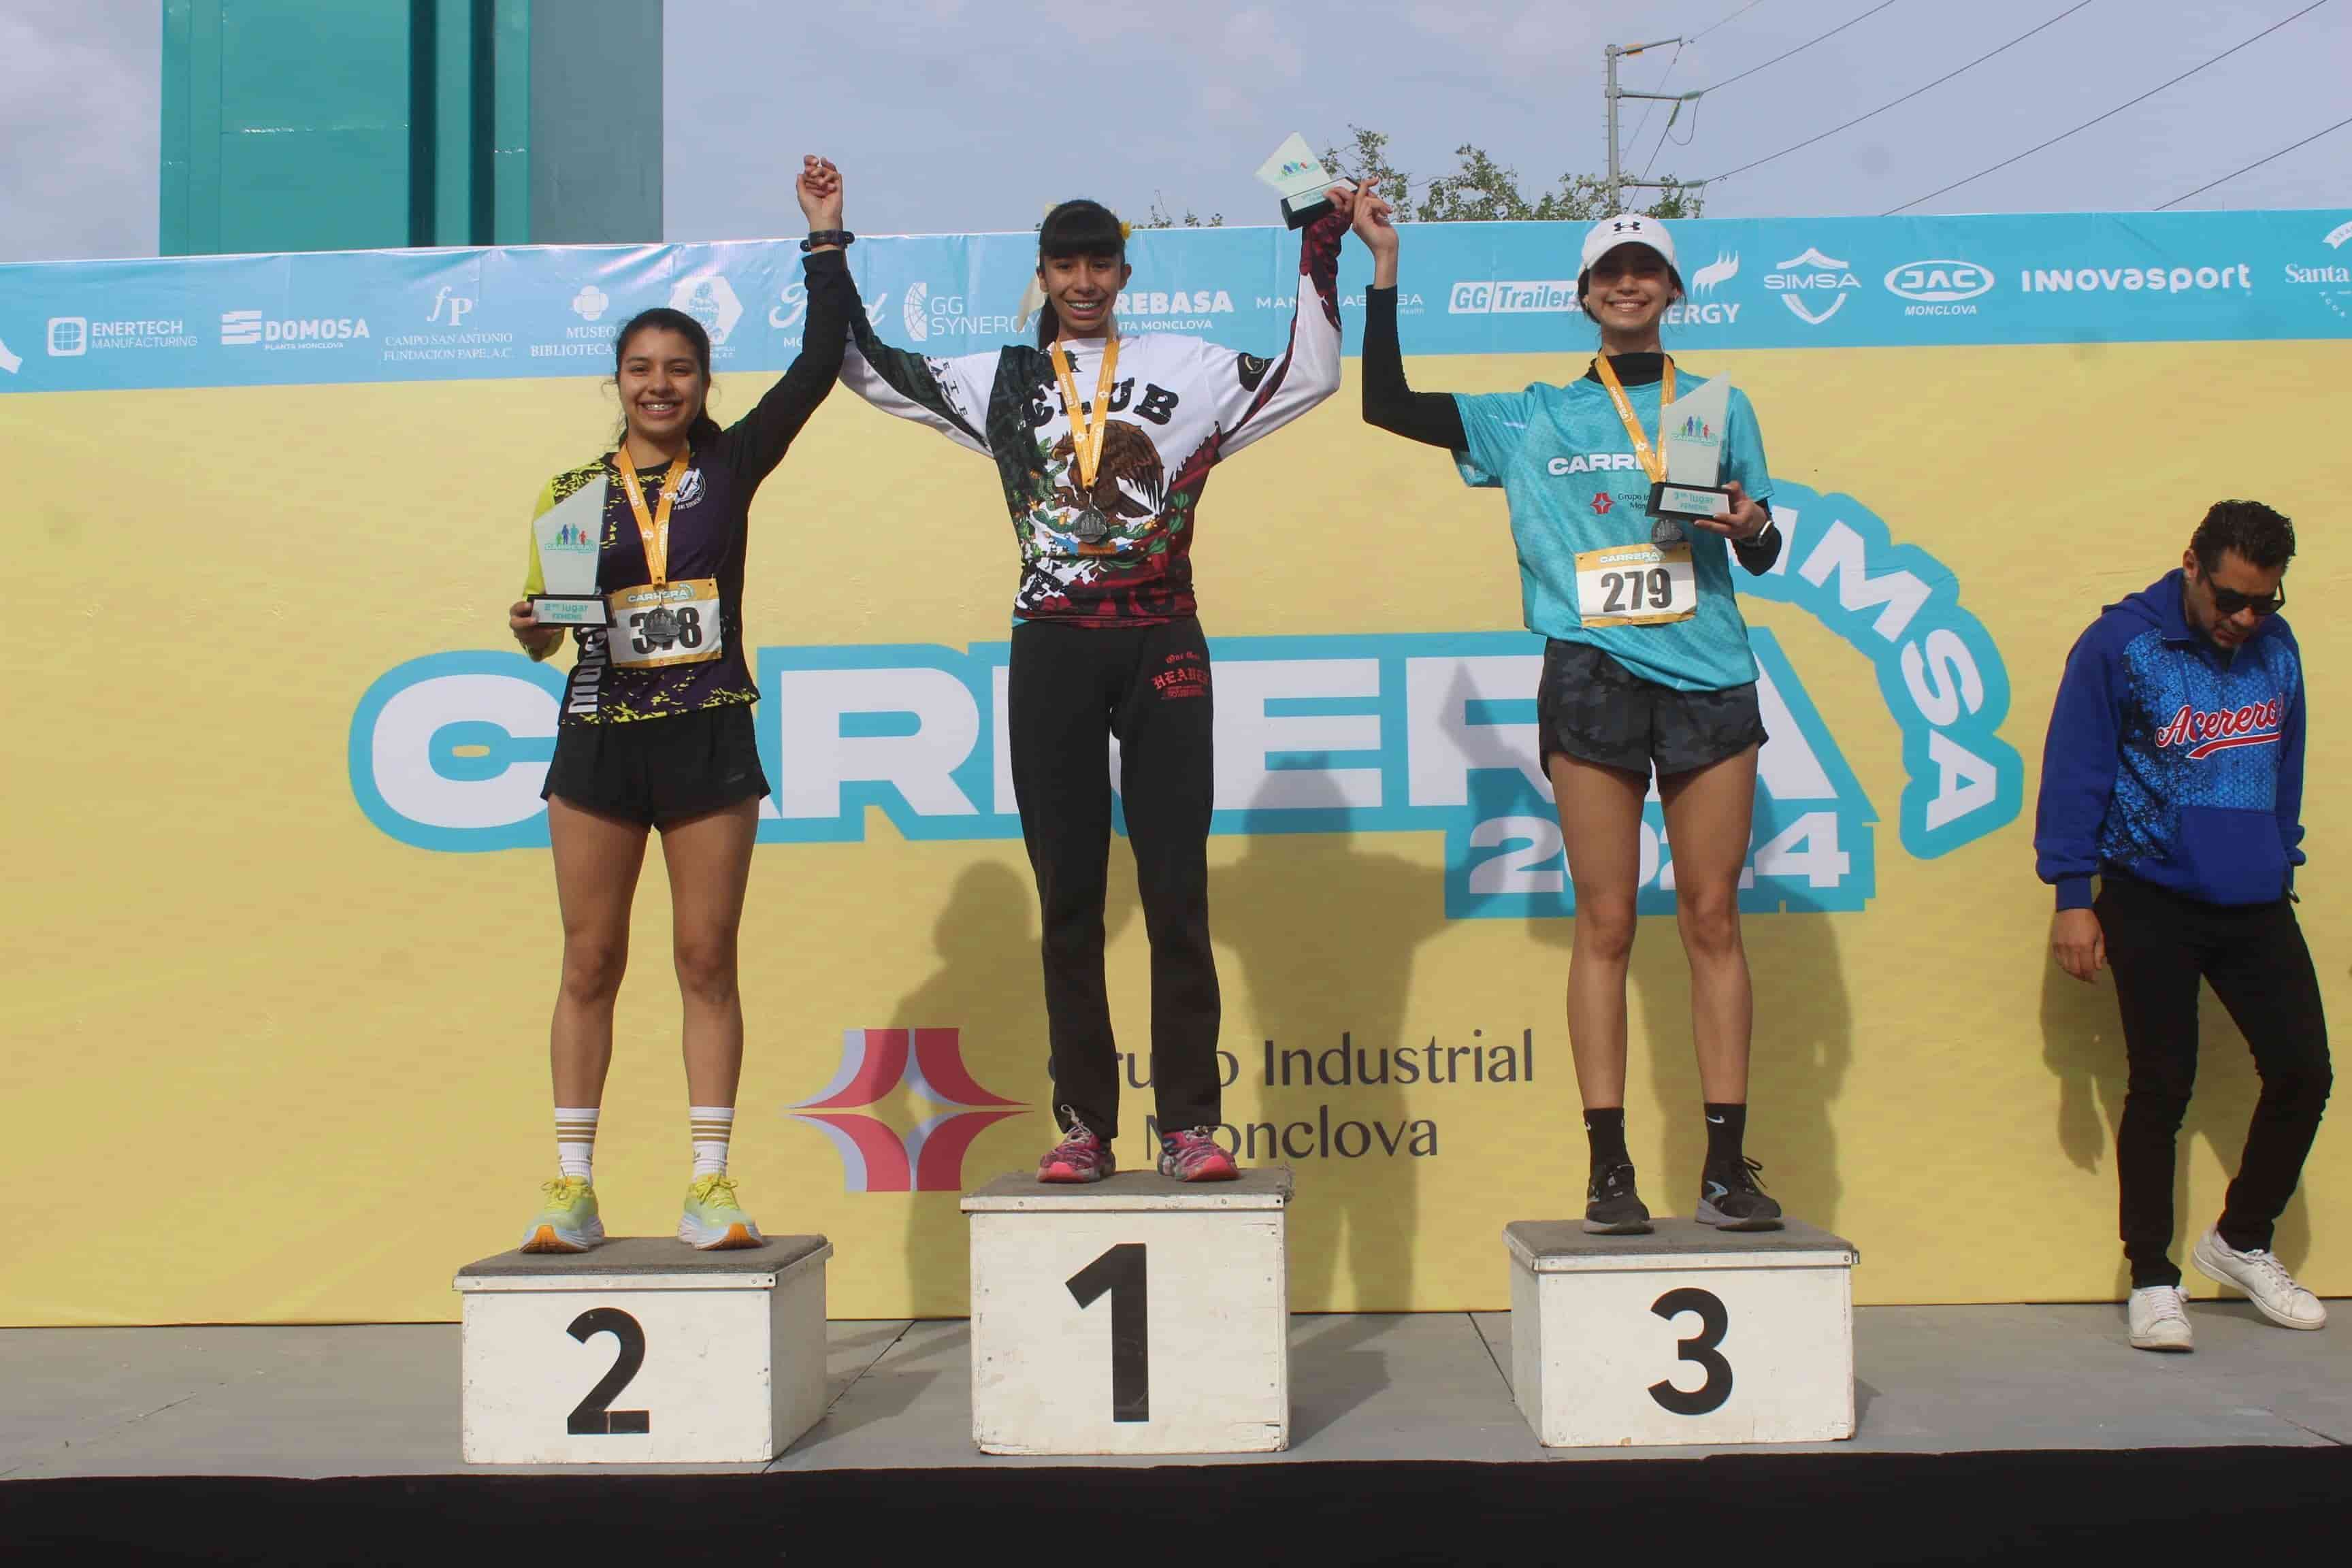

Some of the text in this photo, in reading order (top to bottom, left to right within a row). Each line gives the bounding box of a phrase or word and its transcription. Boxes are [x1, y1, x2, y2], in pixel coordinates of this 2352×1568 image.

[1764, 273, 1862, 289] SIMSA
[1901, 270, 1976, 289] JAC
[2285, 263, 2350, 283] Santa
[931, 297, 963, 314] GG
[1112, 290, 1235, 316] REBASA
[1454, 287, 1488, 308] GG
[1905, 305, 1977, 316] MONCLOVA
[92, 320, 184, 337] ENERTECH
[265, 318, 371, 341] DOMOSA
[566, 327, 617, 338] MUSEO
[931, 316, 1041, 336] SYNERGY
[1141, 319, 1213, 330] MONCLOVA
[91, 336, 199, 349] MANUFACTURING
[265, 342, 344, 351] PLANTA MONCLOVA
[385, 332, 512, 346] CAMPO SAN ANTONIO
[531, 343, 615, 357] BIBLIOTECA
[1601, 568, 1672, 612] 279
[630, 607, 702, 655] 38
[2155, 692, 2284, 748] Acerero
[1264, 1028, 1533, 1087] Industrial
[1065, 1243, 1147, 1422] 1
[1648, 1288, 1733, 1415] 3
[566, 1307, 651, 1434] 2
